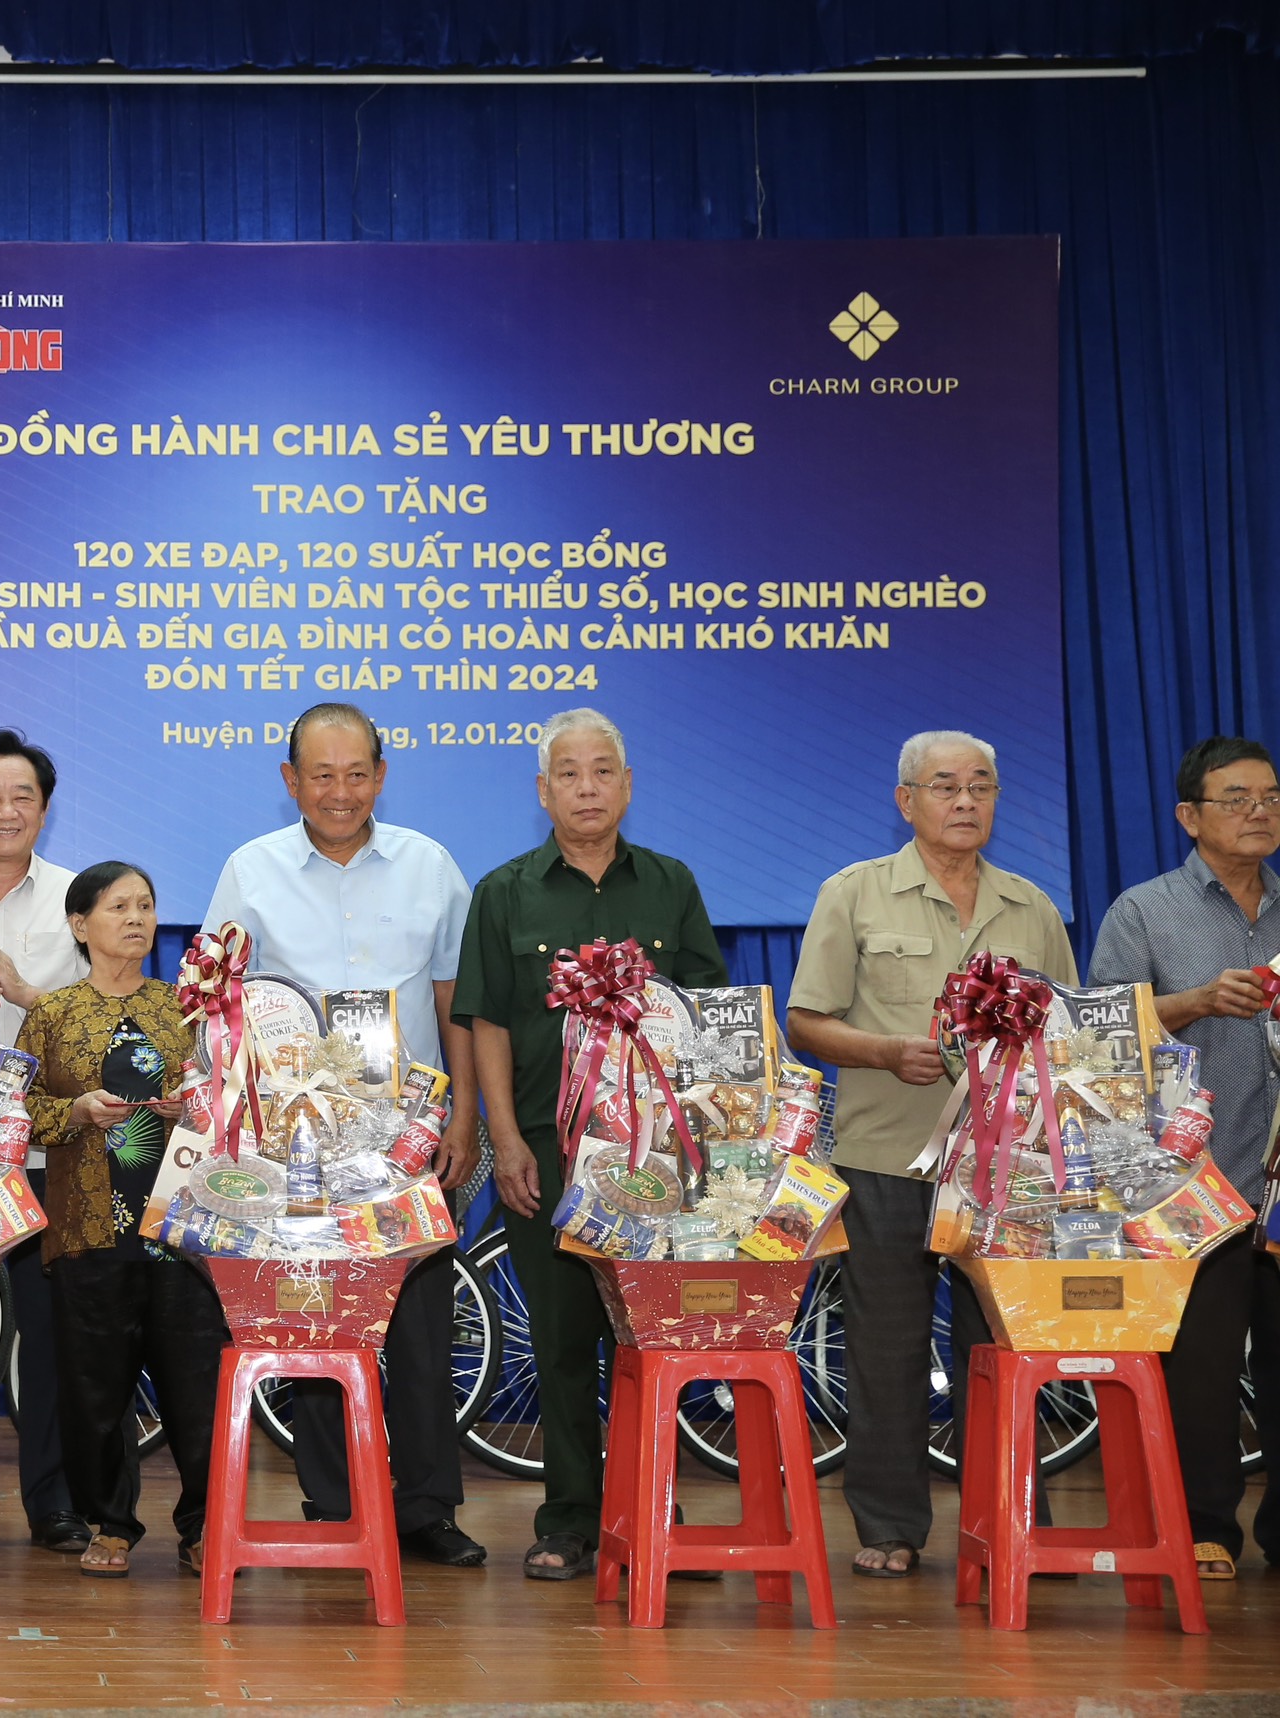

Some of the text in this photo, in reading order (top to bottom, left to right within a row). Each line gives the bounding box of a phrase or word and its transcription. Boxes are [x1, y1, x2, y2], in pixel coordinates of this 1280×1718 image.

[19, 295, 64, 308] MINH
[770, 378, 958, 395] CHARM GROUP
[132, 415, 259, 456] HÀNH
[273, 423, 381, 456] CHIA
[394, 412, 448, 456] SẺ
[461, 415, 549, 456] YÊU
[563, 419, 754, 456] THƯƠNG
[253, 477, 486, 522] TRAO TẶNG
[75, 527, 666, 575] 120 XE ĐẠP, 120 SUẤT HỌC BỔNG
[115, 582, 199, 608] SINH
[211, 575, 296, 608] VIÊN
[308, 576, 384, 608] DÂN
[394, 576, 470, 615] TỘC
[480, 569, 588, 608] THIỂU
[598, 570, 659, 614] SỐ,
[669, 582, 747, 614] HỌC
[758, 582, 843, 608] SINH
[856, 574, 987, 608] NGHÈO
[46, 615, 127, 649] QUÀ
[137, 612, 212, 649] ĐẾN
[223, 623, 288, 649] GIA
[298, 616, 388, 649] ĐÌNH
[399, 615, 452, 649] CÓ
[463, 615, 569, 649] HOÀN
[580, 613, 683, 649] CẢNH
[696, 616, 773, 649] KHÓ
[785, 615, 888, 649] KHĂN
[144, 654, 599, 691] ĐÓN TẾT GIÁP THÌN 2024
[163, 722, 253, 750] Huyện
[427, 722, 544, 746] 12.01.20
[1071, 1222, 1101, 1231] ZELDA
